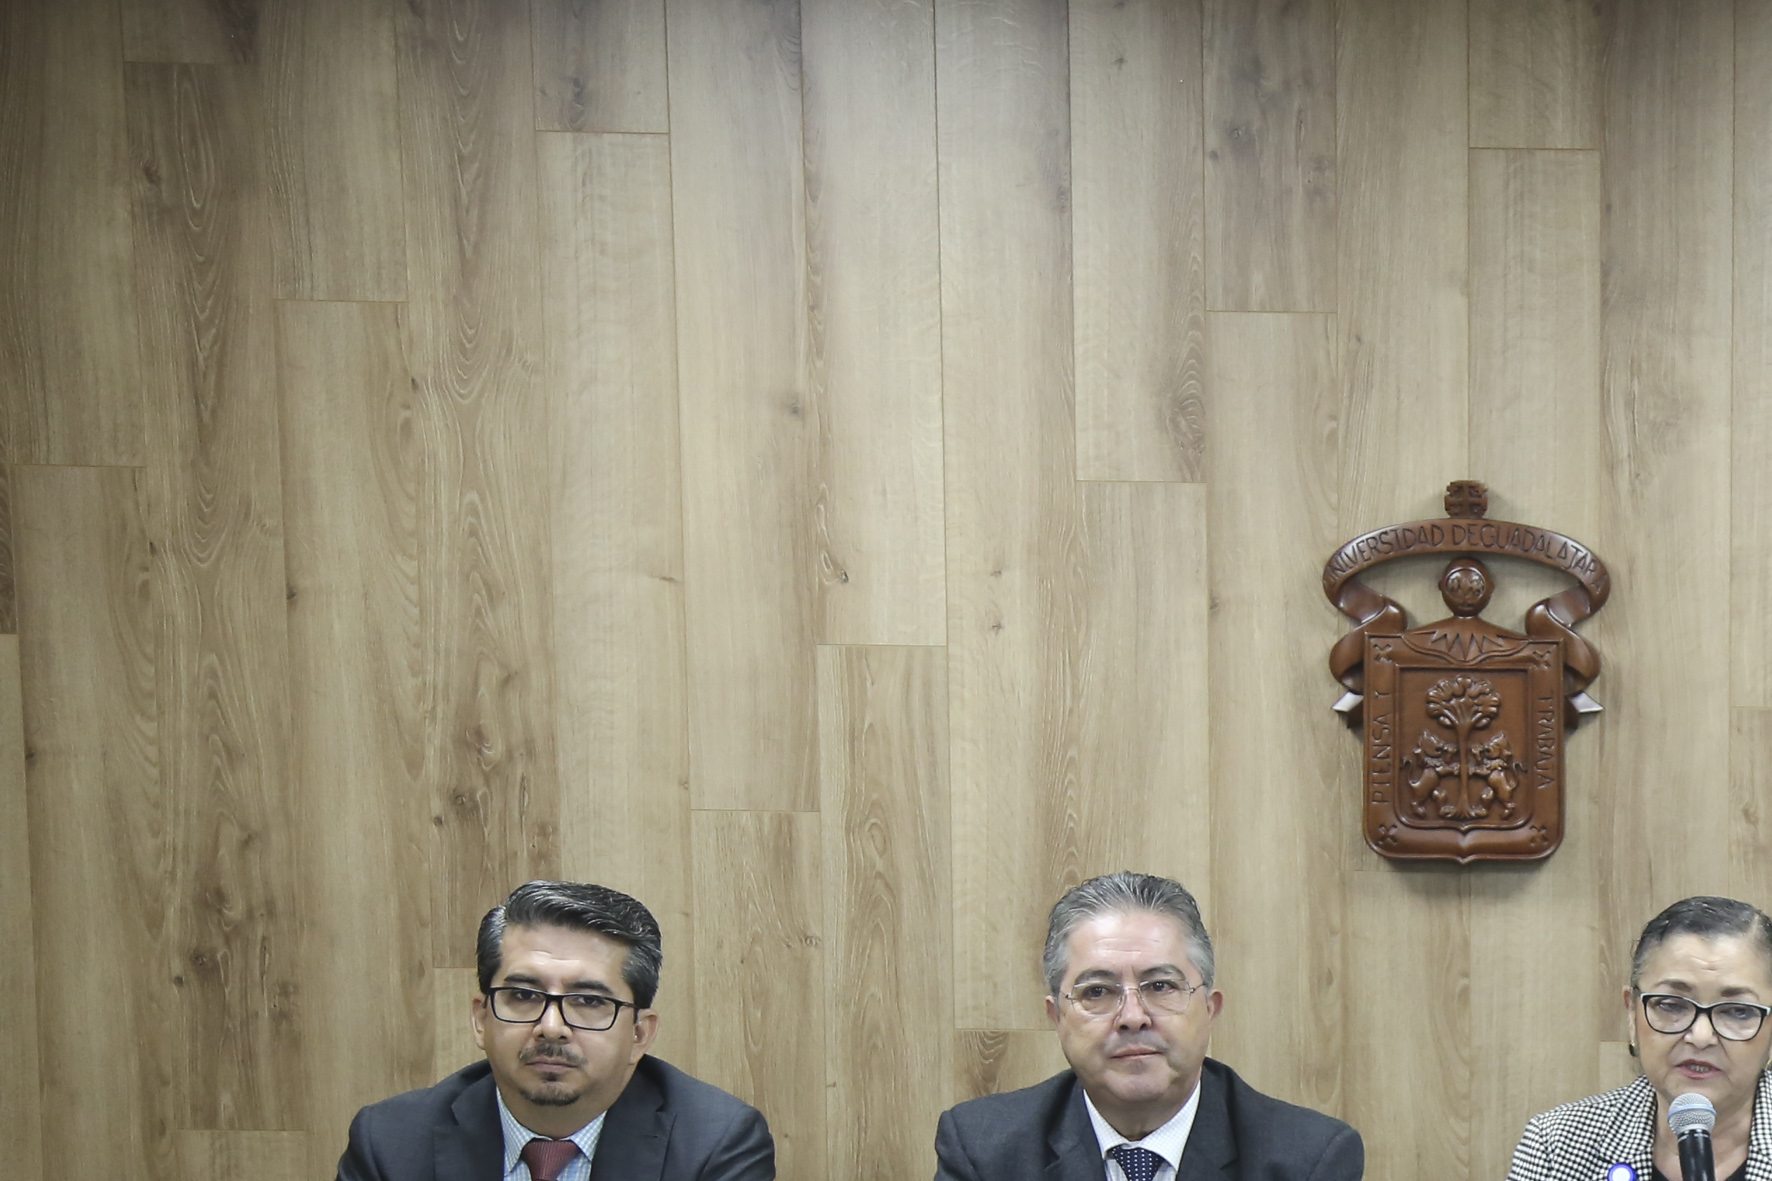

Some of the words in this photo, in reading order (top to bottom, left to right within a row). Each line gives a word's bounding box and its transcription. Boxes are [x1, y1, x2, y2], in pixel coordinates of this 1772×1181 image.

[1452, 523, 1480, 547] DE
[1374, 689, 1390, 698] Y
[1371, 712, 1392, 805] PIENSA
[1535, 690, 1556, 790] TRABAJA
